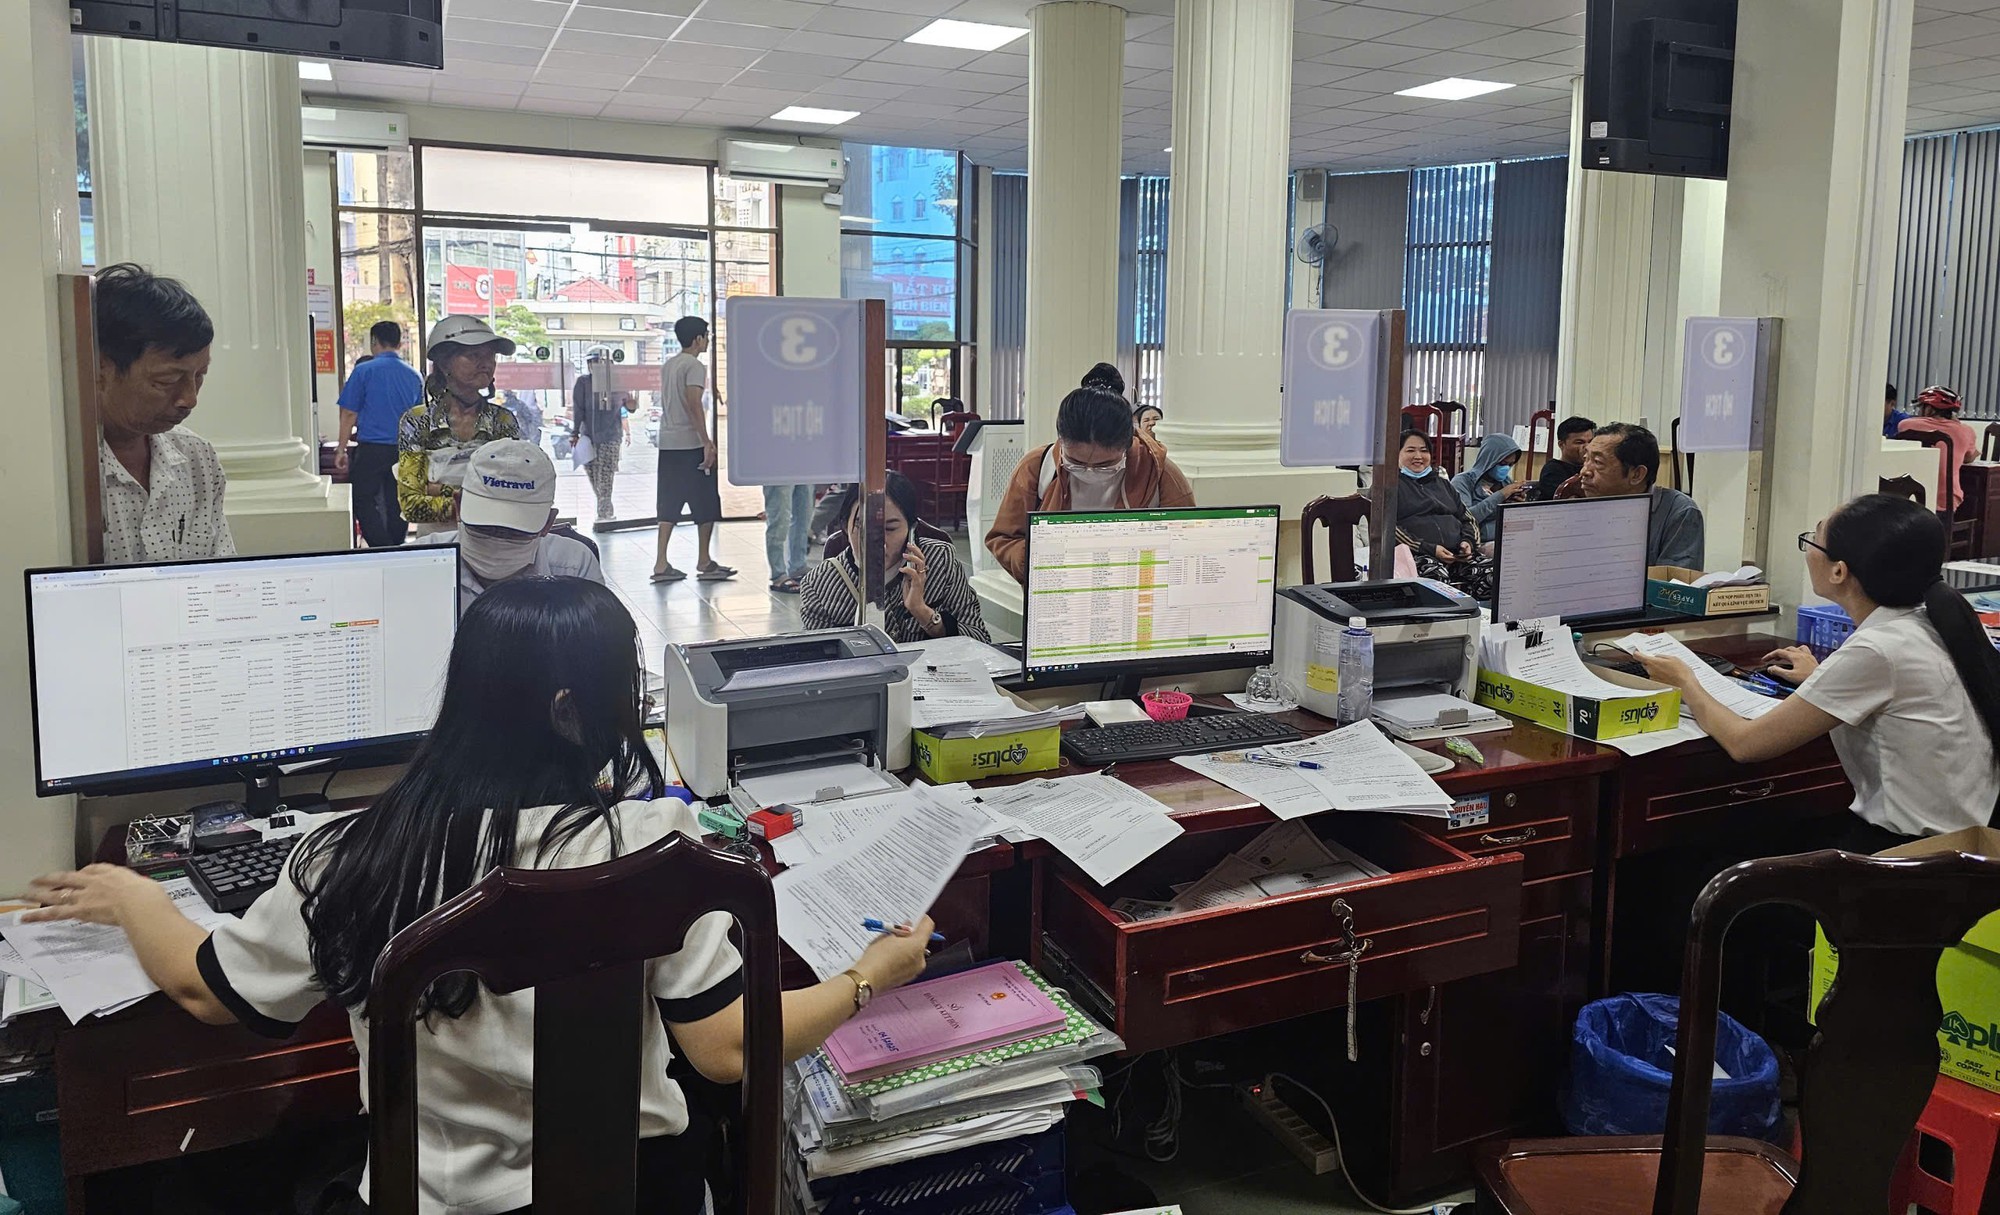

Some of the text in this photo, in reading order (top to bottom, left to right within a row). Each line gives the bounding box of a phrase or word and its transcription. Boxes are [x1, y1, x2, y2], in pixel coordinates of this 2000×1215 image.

[483, 475, 536, 490] Vietravel
[1673, 593, 1694, 604] PAPER
[1552, 700, 1562, 719] A4
[1579, 709, 1590, 725] 70
[1624, 702, 1648, 723] plus
[978, 743, 1013, 767] plus
[1956, 1061, 1991, 1078] COPYING
